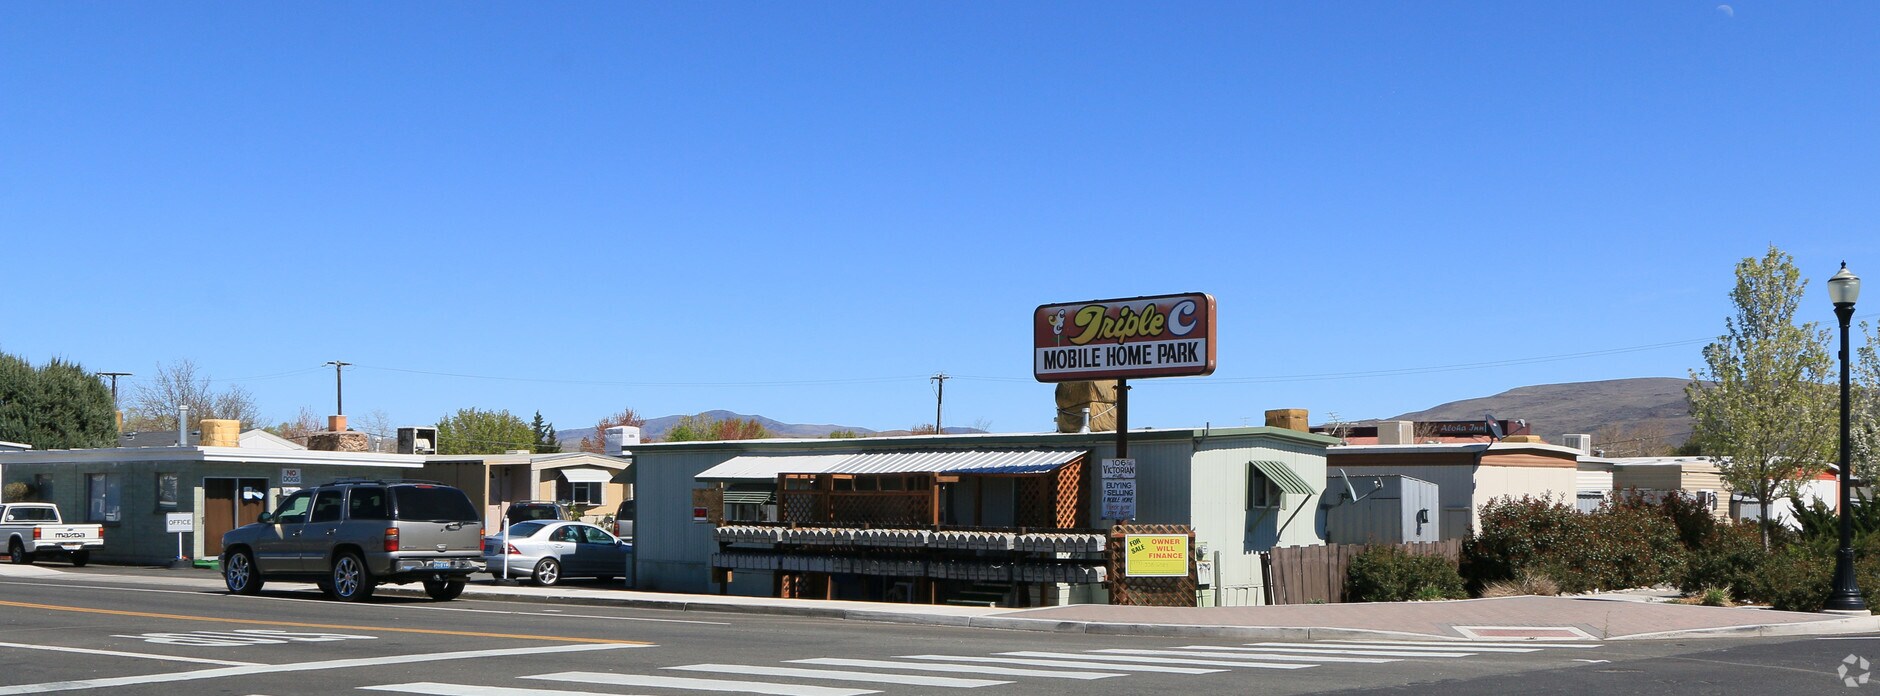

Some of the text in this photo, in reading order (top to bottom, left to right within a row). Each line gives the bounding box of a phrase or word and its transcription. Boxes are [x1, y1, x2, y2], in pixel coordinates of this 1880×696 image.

[1069, 299, 1197, 346] Triple C
[1044, 341, 1199, 370] MOBILE HOME PARK
[1440, 423, 1485, 432] Aloha Inn
[1112, 459, 1126, 467] 106
[1129, 538, 1141, 547] FOR
[1131, 544, 1146, 554] SALE
